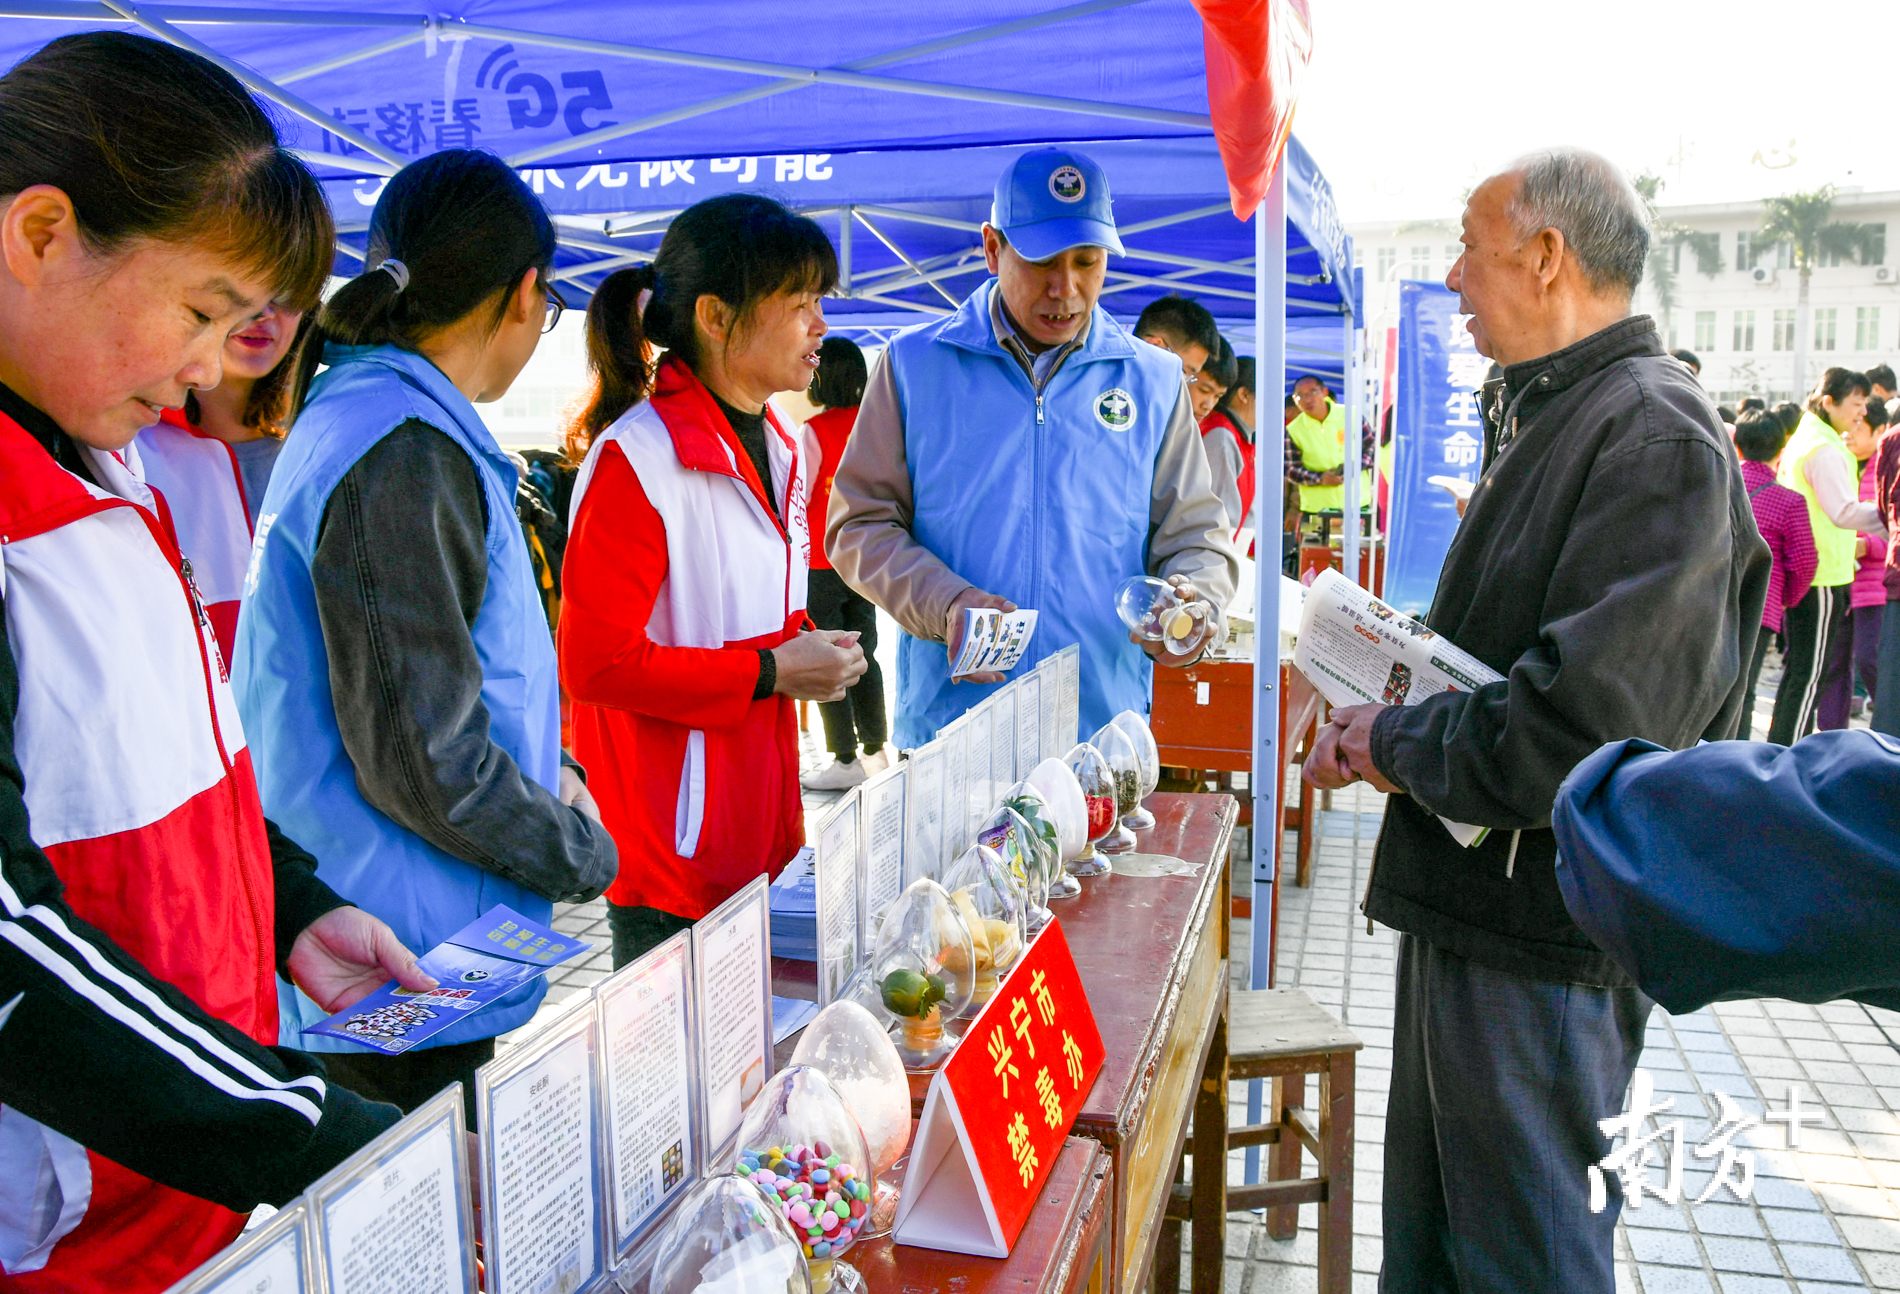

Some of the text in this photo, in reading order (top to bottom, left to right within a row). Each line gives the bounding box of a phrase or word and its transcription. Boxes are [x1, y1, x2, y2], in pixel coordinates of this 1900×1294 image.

[1443, 313, 1484, 467] 珍爱生命
[499, 920, 566, 953] 珍爱生命
[529, 1074, 549, 1098] 安眠酮
[987, 968, 1056, 1099] 兴宁市
[1006, 1029, 1085, 1189] 禁毒办
